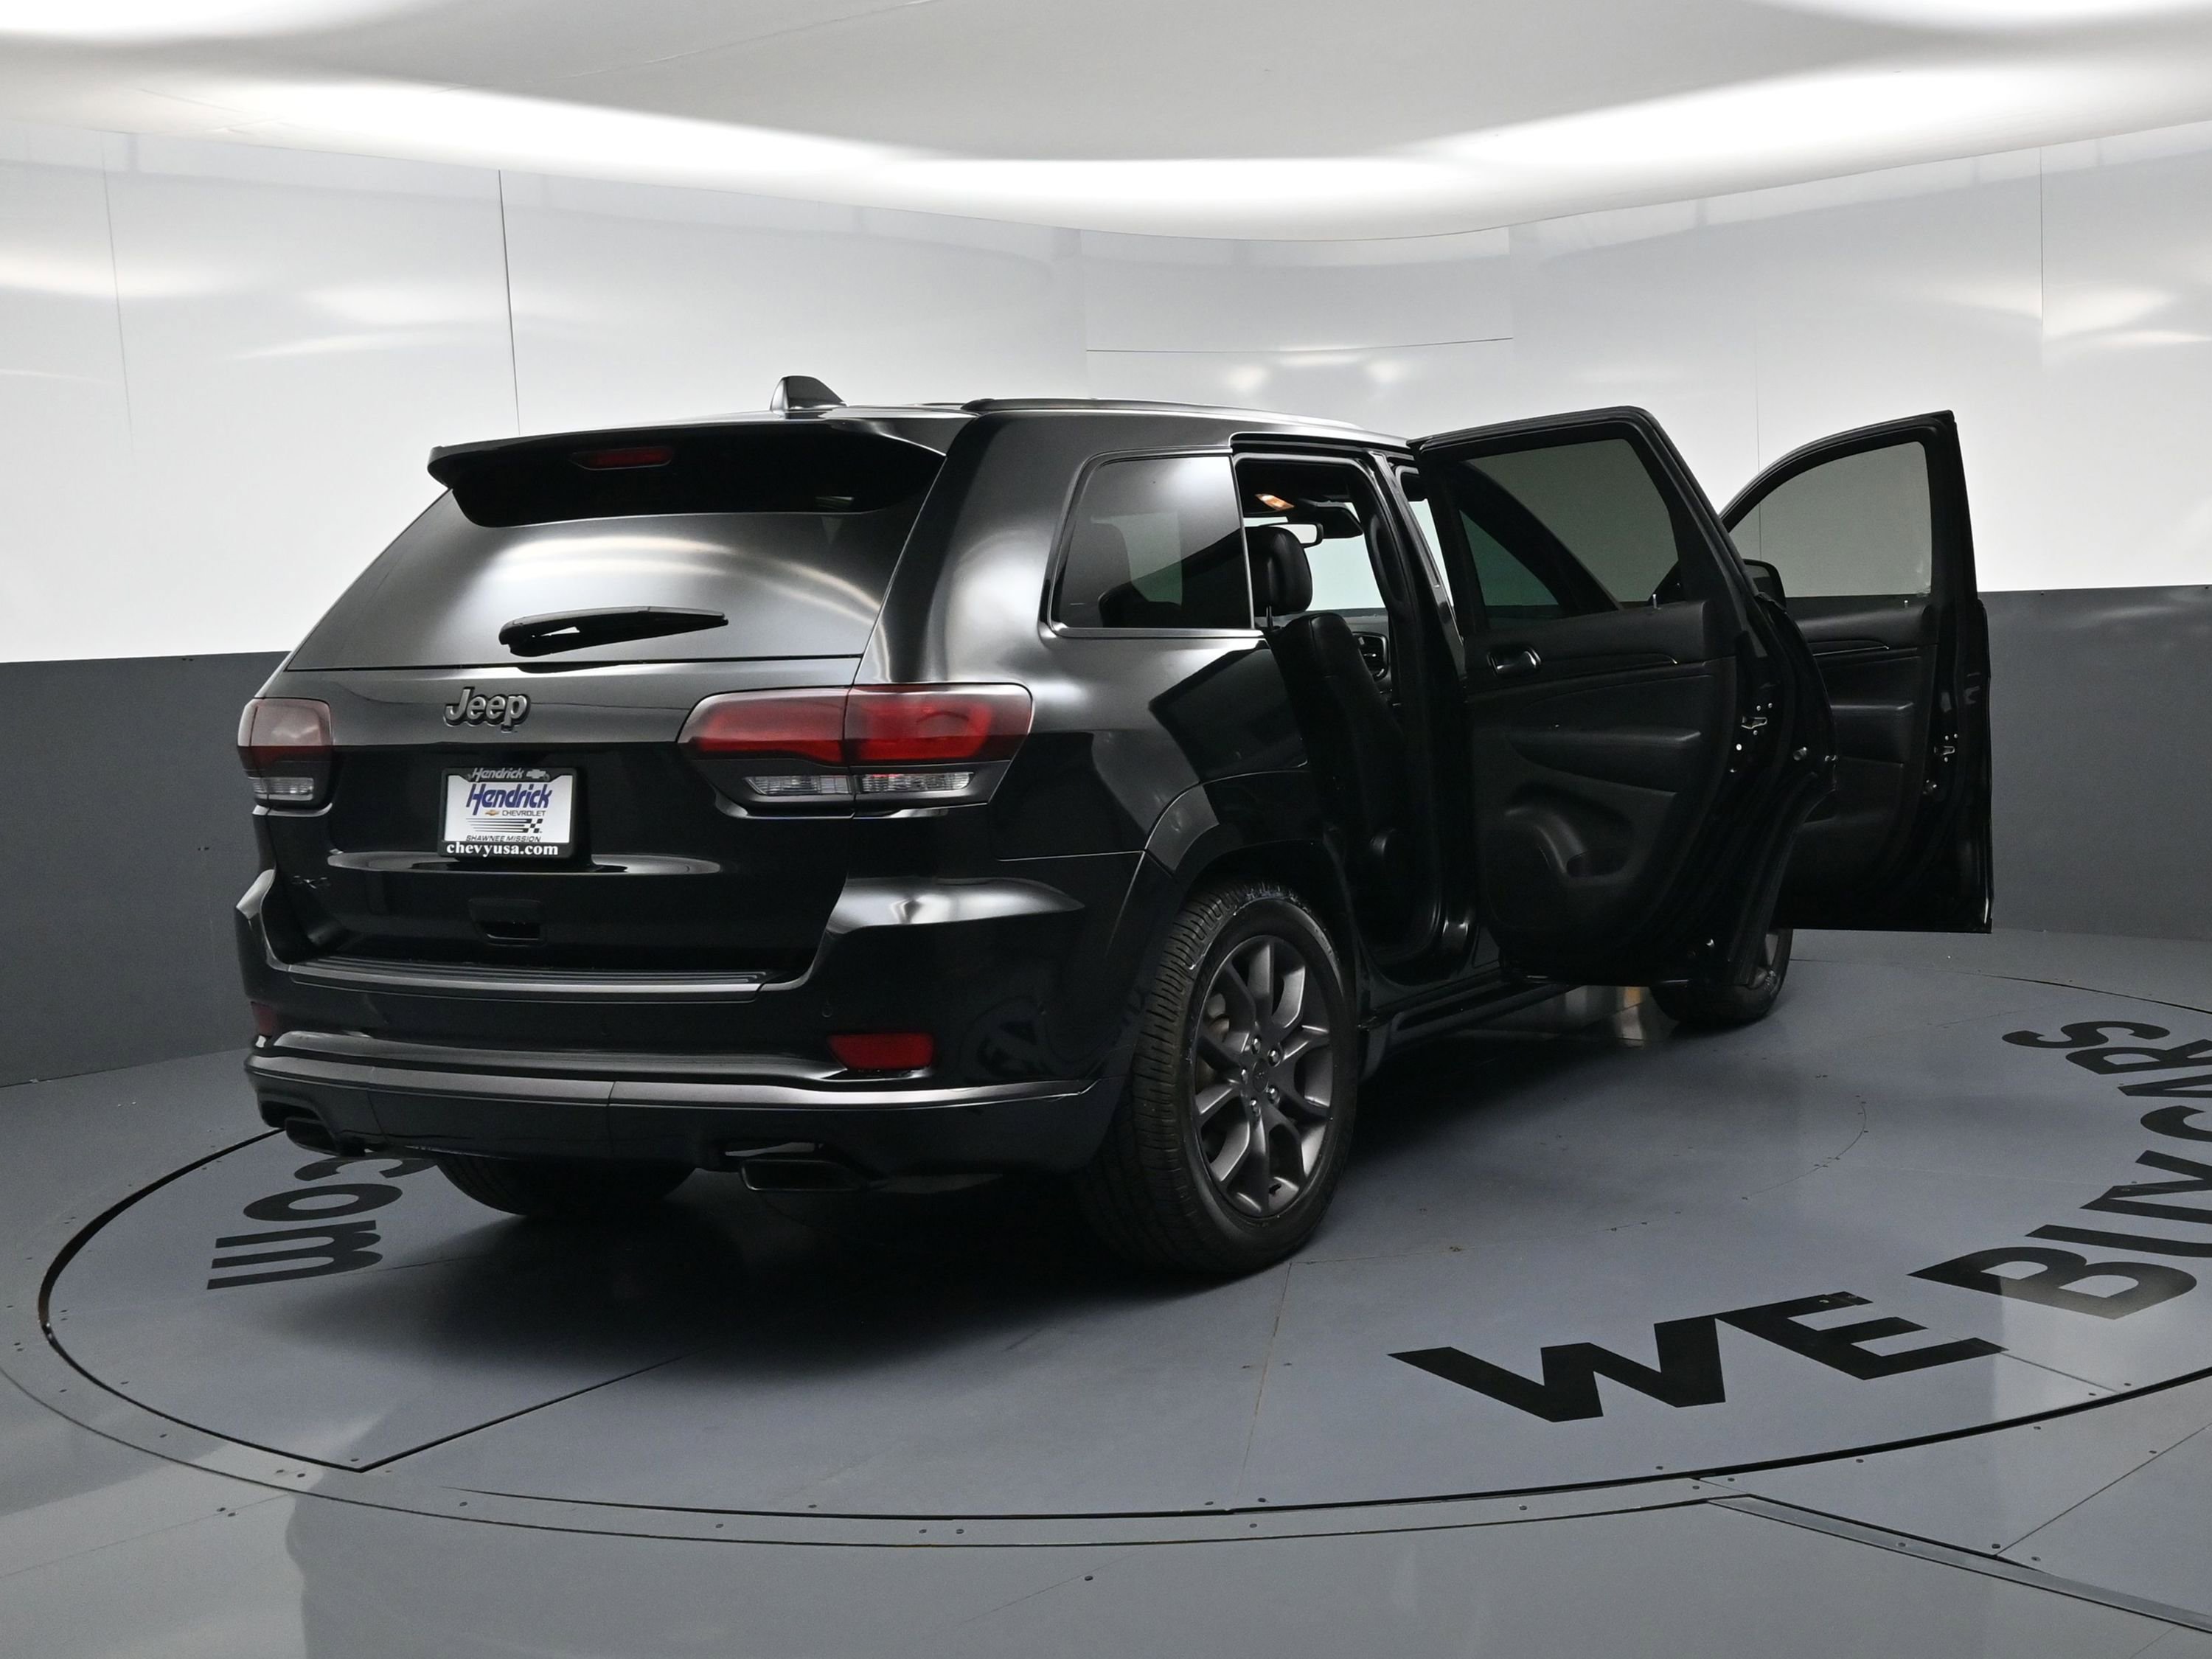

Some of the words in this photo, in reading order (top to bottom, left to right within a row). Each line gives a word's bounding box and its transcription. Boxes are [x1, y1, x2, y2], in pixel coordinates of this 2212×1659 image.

[444, 686, 530, 732] Jeep
[472, 768, 524, 782] Hendrick
[466, 783, 553, 815] Hendrick
[446, 841, 559, 858] chevyusa.com
[506, 835, 542, 843] MISSION
[1387, 1290, 2009, 1423] WE
